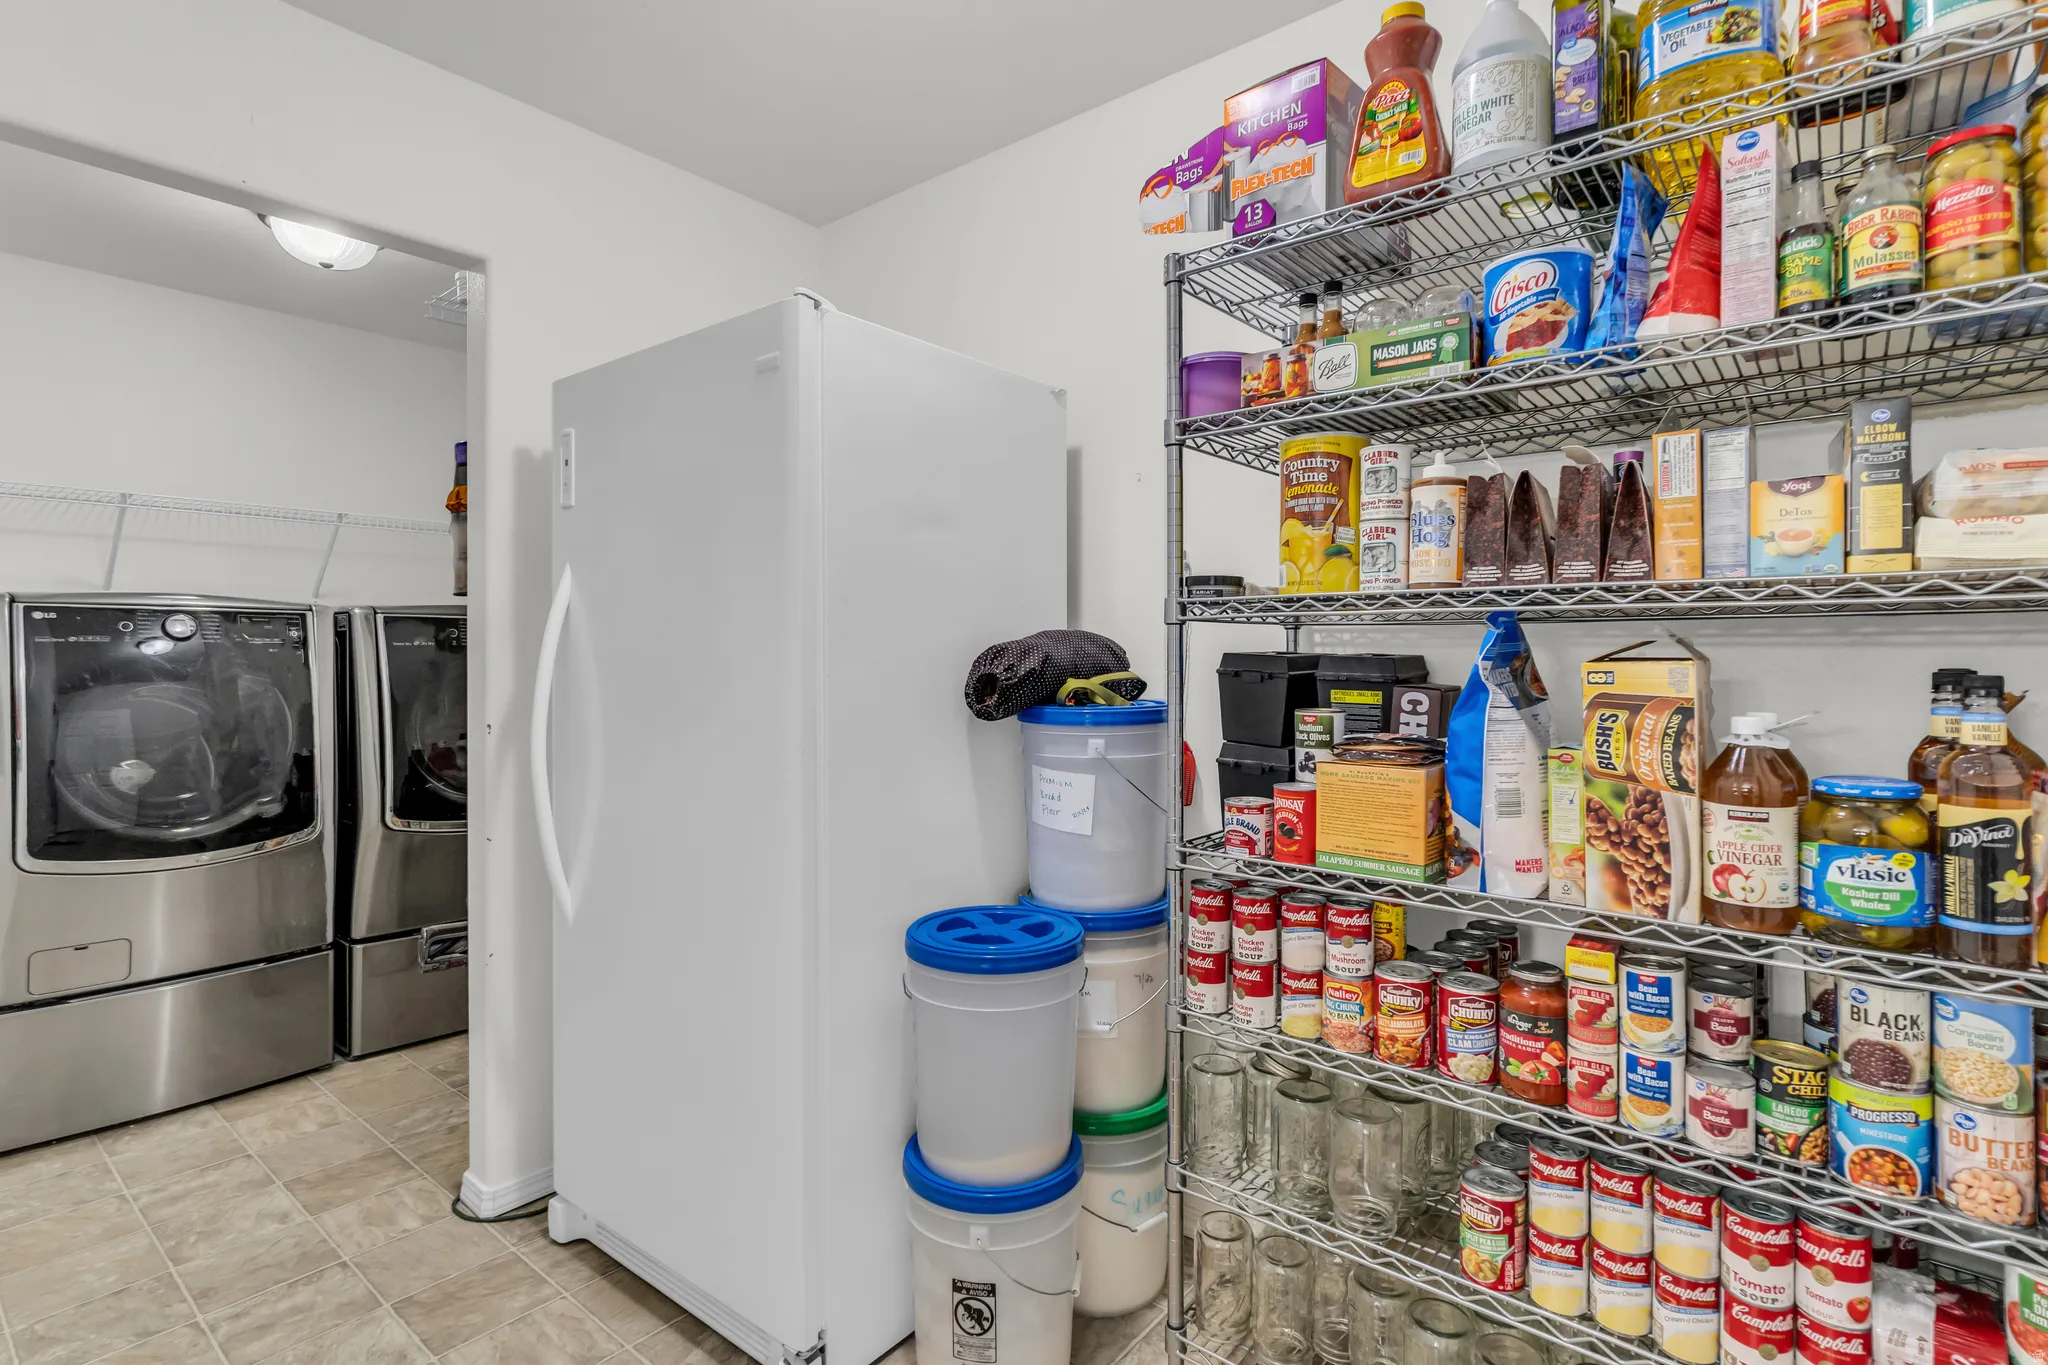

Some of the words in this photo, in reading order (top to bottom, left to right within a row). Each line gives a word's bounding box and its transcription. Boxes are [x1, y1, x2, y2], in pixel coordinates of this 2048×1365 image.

[1661, 19, 1714, 46] VEGETABLE
[1670, 40, 1687, 53] OIL
[1572, 71, 1597, 87] BREAD
[1481, 93, 1515, 111] WHITE
[1236, 100, 1303, 138] KITCHEN
[1287, 117, 1308, 132] Bags
[1725, 150, 1771, 170] Softasilk
[1176, 164, 1203, 184] Bags
[1231, 155, 1315, 200] FLEX-TECH
[1931, 183, 1995, 216] Mezzetta
[1243, 203, 1263, 223] 13
[1244, 217, 1263, 229] GALLON
[1847, 214, 1875, 236] BRER
[1881, 207, 1922, 224] RABBIT
[1941, 223, 1981, 240] OLIVES
[1792, 237, 1818, 251] Luck
[1853, 250, 1916, 269] Molasses
[1786, 265, 1806, 278] OIL
[1495, 272, 1549, 313] Crisco
[1373, 343, 1408, 361] MASON
[1410, 338, 1437, 354] JARS
[1318, 353, 1352, 380] Ball
[1864, 423, 1897, 434] ELBOW
[1856, 432, 1906, 444] MACARONI
[1364, 450, 1399, 462] CLABBER
[1283, 455, 1340, 475] Country
[1290, 470, 1328, 485] Time
[1286, 482, 1339, 501] Lemonade
[1781, 480, 1812, 493] yogi
[1411, 512, 1456, 527] Blues
[1779, 507, 1813, 517] DeTox
[1362, 526, 1397, 537] CLABBER
[1412, 528, 1450, 548] Hog
[1588, 673, 1606, 683] 8
[1664, 714, 1682, 751] BEANS
[1972, 724, 2001, 734] VANILLA
[1310, 733, 1330, 741] Olives
[1596, 712, 1620, 771] BUSH'S
[1972, 734, 2001, 742] VANILLE
[1636, 712, 1657, 781] Original
[1662, 752, 1679, 787] BAKED
[1729, 811, 1769, 819] KIRKLAND
[1236, 818, 1260, 835] BRAND
[1949, 824, 2014, 848] DaVinci
[1716, 841, 1747, 852] APPLE
[1751, 844, 1783, 853] CIDER
[1319, 854, 1353, 867] JALAPEÑO
[1354, 858, 1385, 871] SUMMER
[1386, 864, 1421, 877] SAUSAGE
[1515, 858, 1543, 867] MAKERS
[1717, 850, 1782, 866] VINEGAR
[1515, 866, 1543, 874] WANTED
[1836, 864, 1907, 883] vlasic
[1842, 887, 1881, 900] Kosher
[1882, 891, 1900, 901] Dill
[1851, 898, 1891, 911] Wholes
[1328, 909, 1371, 927] Campbell's
[1191, 926, 1215, 936] Chicken
[1192, 932, 1214, 942] Noodle
[1191, 940, 1213, 949] SOUP
[1238, 937, 1265, 946] Chicken
[1239, 944, 1263, 952] Noodle
[1239, 952, 1263, 960] SOUP
[1331, 954, 1366, 964] Mushroom
[1335, 966, 1361, 974] SOUP
[1328, 987, 1358, 1001] Nalley
[1572, 988, 1588, 996] MUIR
[1591, 991, 1610, 1000] GLEN
[1638, 984, 1658, 993] Bean
[1381, 991, 1421, 1008] CHUNKY
[1628, 991, 1644, 999] with
[1646, 994, 1670, 1003] Bacon
[1336, 1001, 1360, 1013] CHUNK
[1451, 1004, 1493, 1020] CHUNKY
[1337, 1011, 1358, 1020] BEANS
[1508, 1014, 1532, 1031] Kroger
[1851, 1004, 1920, 1031] BLACK
[1710, 1021, 1738, 1033] Beets
[1947, 1024, 2004, 1043] Cannellini
[1448, 1038, 1472, 1048] CLAM
[1500, 1029, 1545, 1048] Traditional
[1884, 1030, 1925, 1041] BEANS
[1521, 1045, 1540, 1053] SAUCE
[1968, 1038, 2004, 1052] Beans
[1571, 1058, 1588, 1067] MUIR
[1590, 1063, 1610, 1072] GLEN
[1637, 1066, 1657, 1077] Bean
[1627, 1072, 1643, 1083] with
[1645, 1077, 1668, 1088] Bacon
[1703, 1110, 1731, 1124] Beets
[1772, 1102, 1810, 1118] LAREDO
[1851, 1106, 1916, 1123] PROGRESSO
[1860, 1127, 1908, 1143] MINESTRONE
[1948, 1127, 2034, 1159] BUTTER
[1987, 1157, 2034, 1172] BEANS
[1462, 1199, 1500, 1227] CHUNKY
[1676, 1228, 1702, 1238] Chicken
[1726, 1214, 1791, 1245] Campbell's
[1593, 1247, 1647, 1275] Campbell's
[963, 1282, 991, 1290] WARNING
[1659, 1273, 1717, 1301] Campbell's
[1732, 1270, 1786, 1295] Tomato
[1739, 1288, 1779, 1305] SOUP
[1804, 1286, 1843, 1309] Tomato
[1664, 1315, 1684, 1323] Cream
[1811, 1306, 1834, 1319] SOUP
